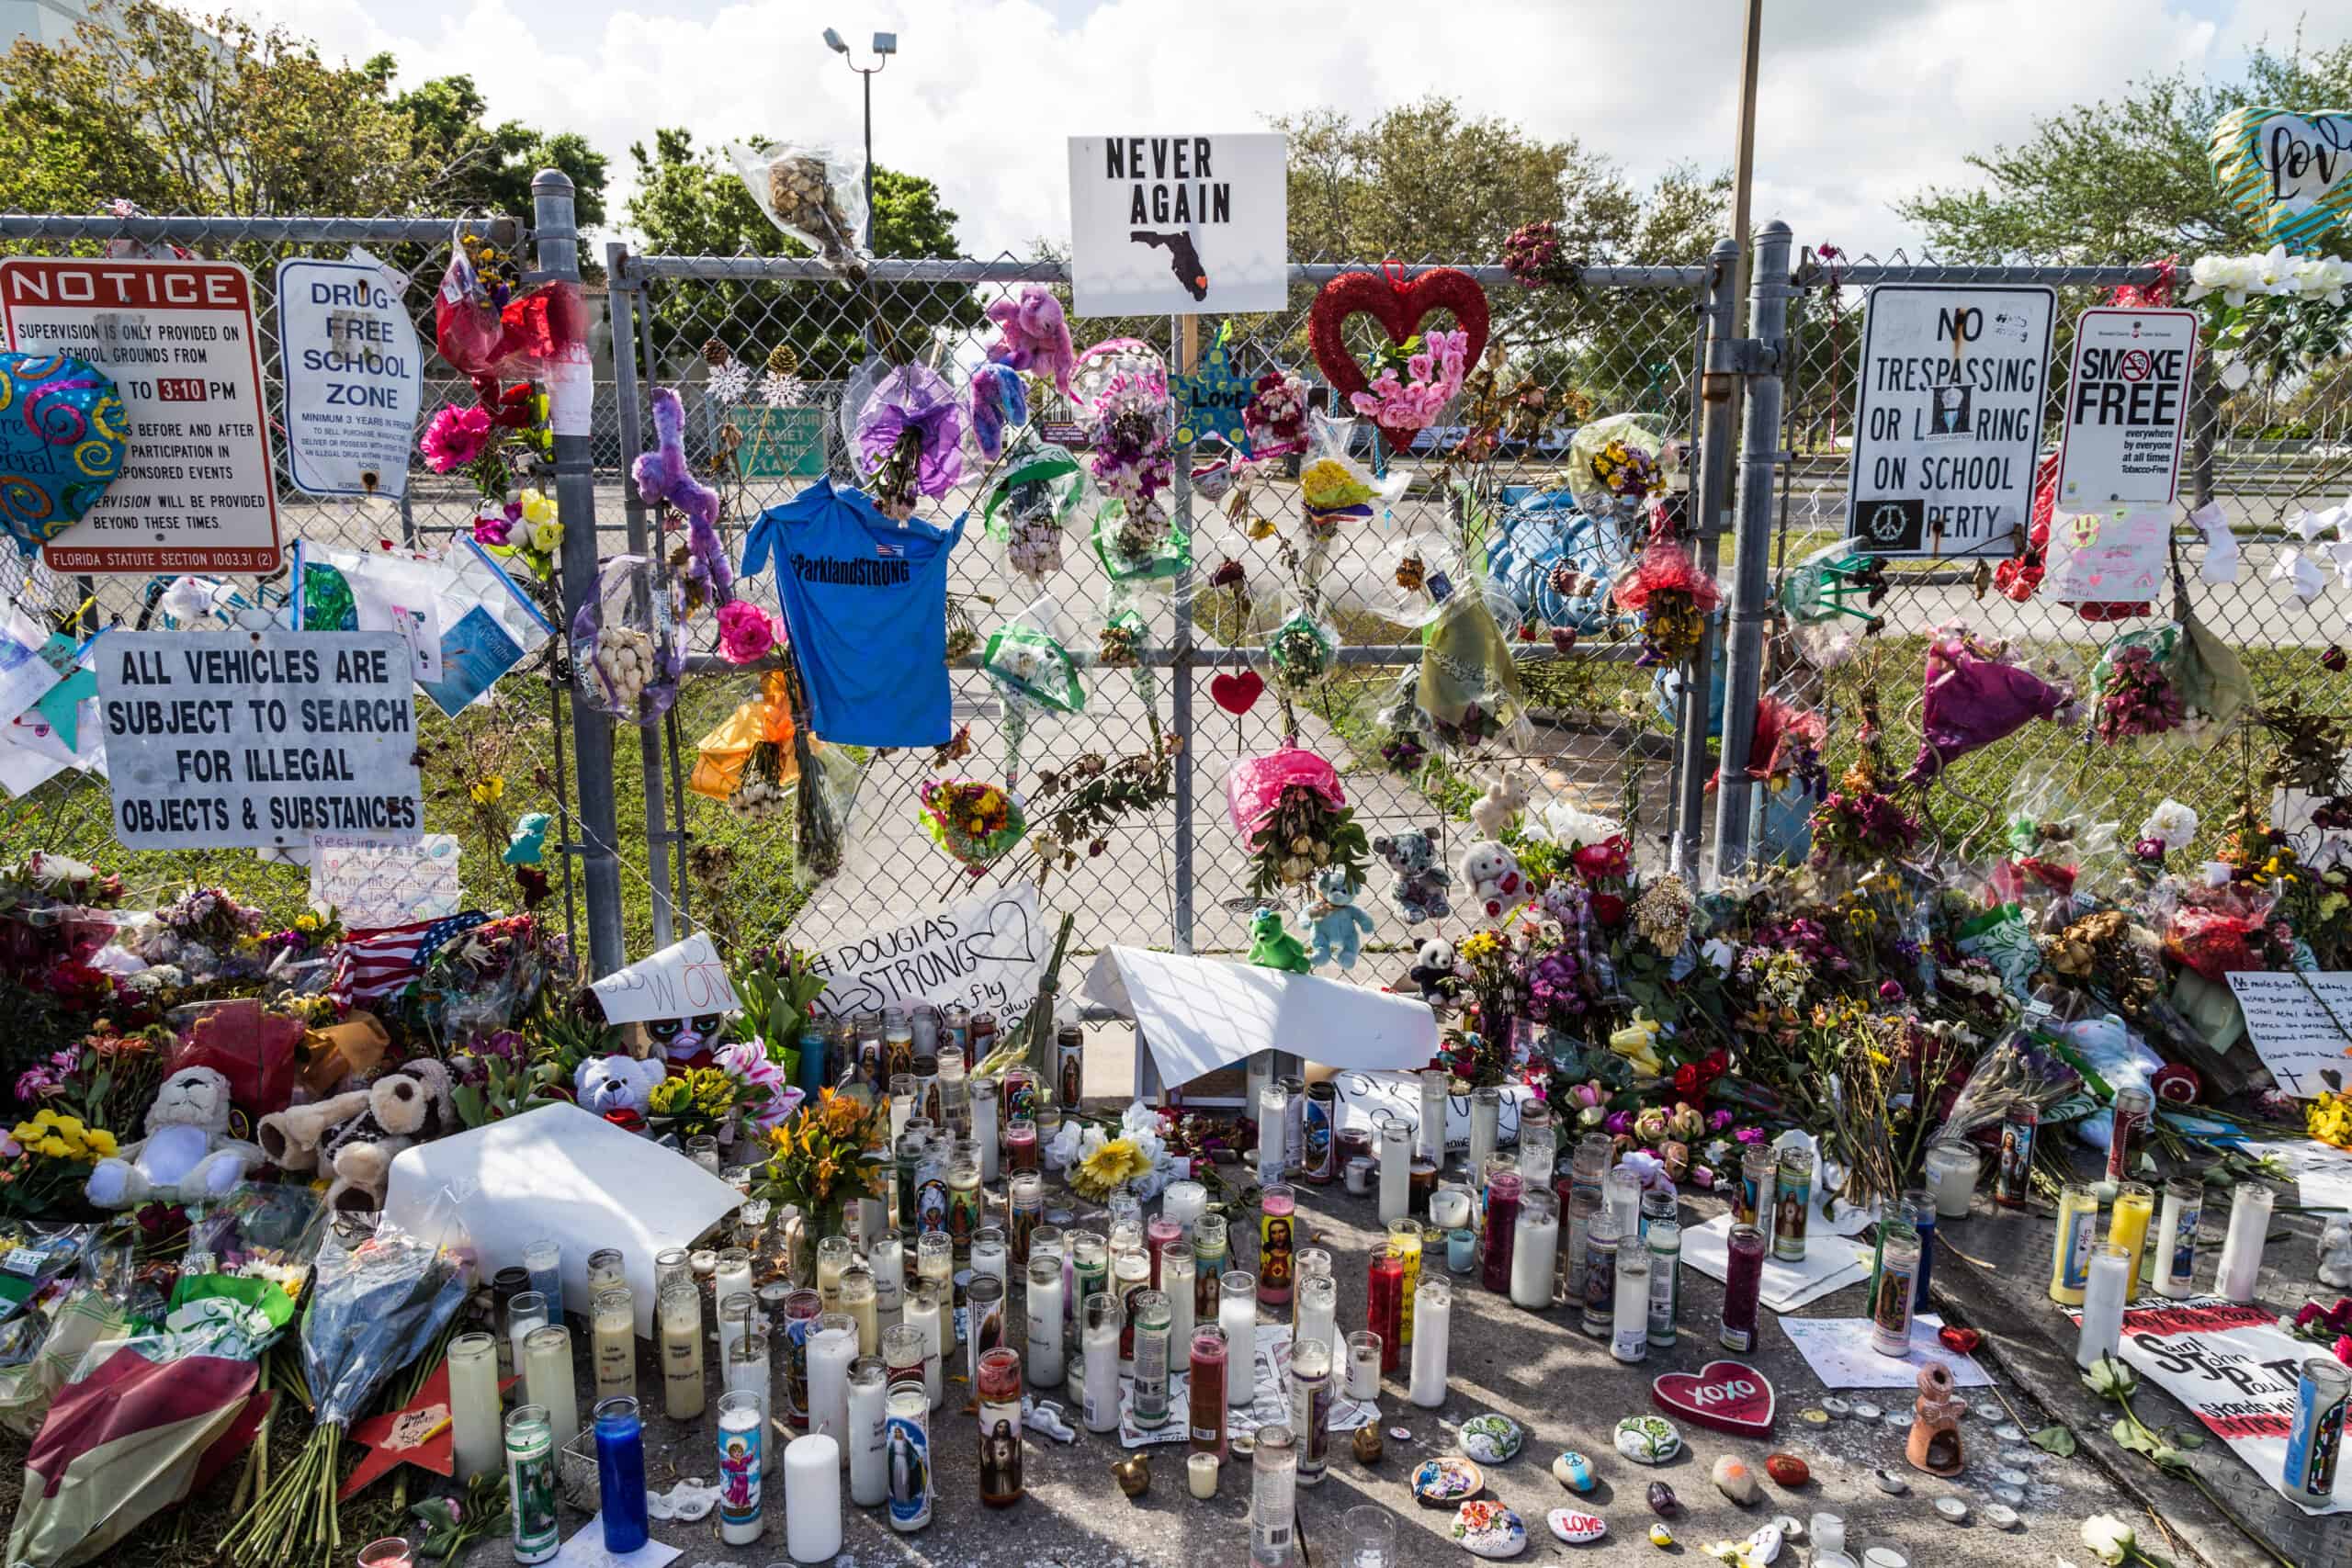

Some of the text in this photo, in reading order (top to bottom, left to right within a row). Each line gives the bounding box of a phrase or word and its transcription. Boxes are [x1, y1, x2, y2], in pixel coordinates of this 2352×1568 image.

[1105, 137, 1213, 180] NEVER
[2252, 117, 2352, 208] Lov
[1129, 183, 1230, 225] AGAIN
[10, 270, 238, 305] NOTICE
[311, 283, 398, 310] DRUG-
[18, 323, 240, 341] SUPERVISION IS ONLY PROVIDED ON
[326, 317, 394, 344] FREE
[1937, 308, 1984, 343] NO
[59, 347, 208, 364] SCHOOL GROUNDS FROM
[303, 349, 411, 379] SCHOOL
[1877, 357, 2037, 393] TRESPASSING
[130, 382, 153, 400] TO
[164, 383, 201, 400] 3:10
[210, 382, 236, 400] PM
[326, 383, 399, 411] ZONE
[2075, 382, 2178, 426] FREE
[140, 423, 184, 437] BEFORE
[189, 423, 211, 437] AND
[218, 423, 254, 437] AFTER
[301, 412, 344, 423] MINIMUM
[345, 415, 353, 424] 3
[356, 416, 384, 427] YEARS
[784, 413, 821, 426] YOUR
[1871, 408, 2031, 442] OR LRING
[748, 430, 805, 442] HEMET
[2123, 441, 2172, 449] by everyone
[2125, 429, 2174, 439] everywhere
[131, 446, 231, 458] PARTICIPATION IN
[2122, 453, 2170, 462] at all times
[118, 467, 233, 480] SPONSORED EVENTS
[1874, 457, 2014, 491] ON SCHOOL
[2121, 465, 2169, 474] Tobacco-Free
[95, 495, 266, 508] ERVISION WILL BE PROVIDED
[94, 516, 222, 530] BEYOND THESE TIMES.
[1926, 506, 2001, 539] PERTY
[52, 553, 273, 567] FLORIDA STATUTE SECTION 1003.31 (2)
[121, 649, 389, 684] ALL VEHICLES ARE
[107, 699, 409, 735] SUBJECT TO SEARCH
[175, 748, 354, 784] FOR ILLEGAL
[122, 795, 416, 833] OBJECTS & SUBSTANCES
[859, 939, 978, 1012] STRONG
[970, 980, 1007, 1010] fly
[1001, 993, 1060, 1019] alwas
[2133, 1334, 2208, 1374] Saint
[2182, 1347, 2250, 1381] John
[1685, 1380, 1757, 1406] XOXO
[2218, 1365, 2288, 1396] Paul
[1562, 1516, 1604, 1532] LOVE
